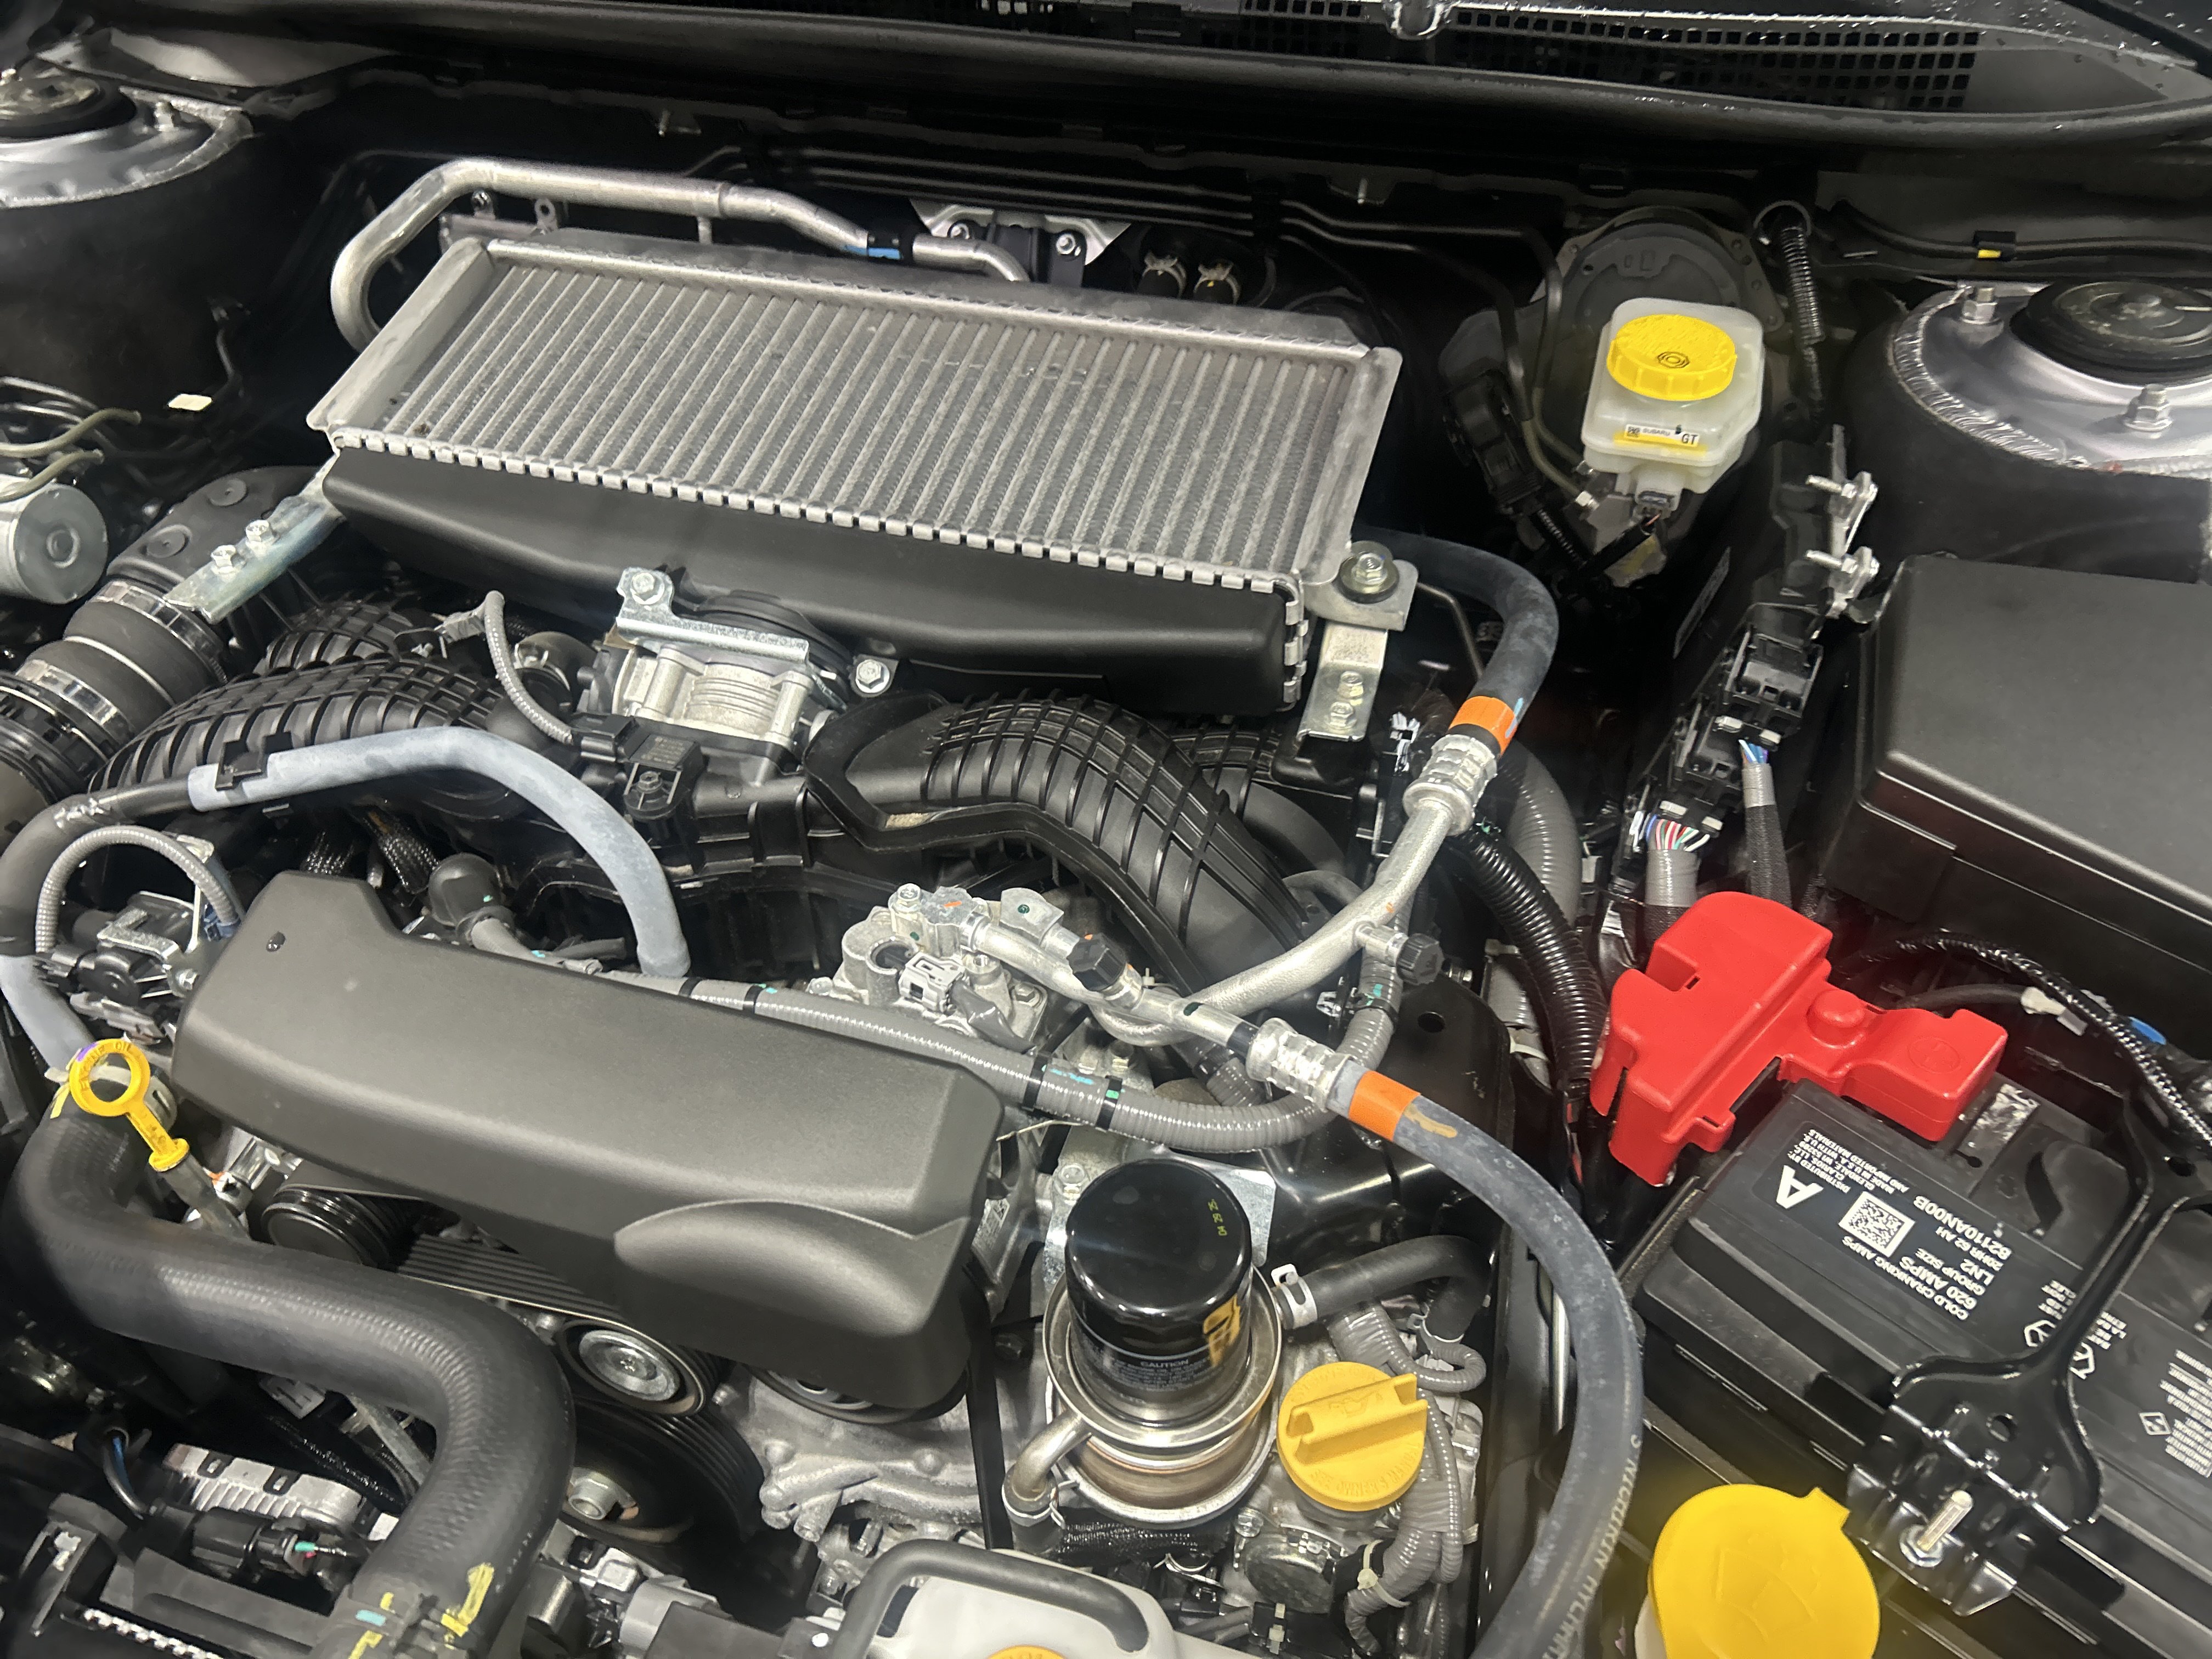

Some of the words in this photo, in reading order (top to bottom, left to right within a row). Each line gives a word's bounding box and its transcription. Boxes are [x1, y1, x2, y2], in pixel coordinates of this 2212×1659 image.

[1681, 433, 1699, 445] GT
[115, 1041, 131, 1052] OIL
[1804, 1133, 1820, 1147] U.S.
[1808, 1130, 1852, 1158] MATERIALS
[1817, 1144, 1840, 1159] WITH
[1787, 1151, 1802, 1163] BY:
[1811, 1154, 1846, 1181] CLARIOS,
[1821, 1155, 1833, 1165] WI
[1838, 1155, 1863, 1173] U.S.A.
[1850, 1155, 1891, 1182] IMPORTED
[1801, 1157, 1850, 1193] DISTRIBUTED
[1835, 1161, 1875, 1190] GLENDALE,
[1861, 1171, 1872, 1180] IN
[1870, 1176, 1895, 1194] MADE
[1889, 1177, 1909, 1193] AND
[1776, 1165, 1824, 1209] A
[1914, 1196, 2011, 1260] 82110AN00B
[1936, 1227, 1957, 1242] AH
[1842, 1236, 1876, 1260] AMPS
[1955, 1238, 1971, 1251] 62
[1915, 1248, 1944, 1269] SIZE
[1970, 1247, 2004, 1271] 20HR
[1875, 1256, 1935, 1299] CRANKING
[1899, 1257, 1949, 1290] AMPS
[1942, 1267, 1985, 1295] GROUP
[1960, 1259, 1994, 1285] LN2
[1934, 1295, 1968, 1320] COLD
[1946, 1286, 1977, 1309] 620
[1139, 1358, 1189, 1368] CAUTION
[1593, 1458, 1638, 1571] NICHIRIN
